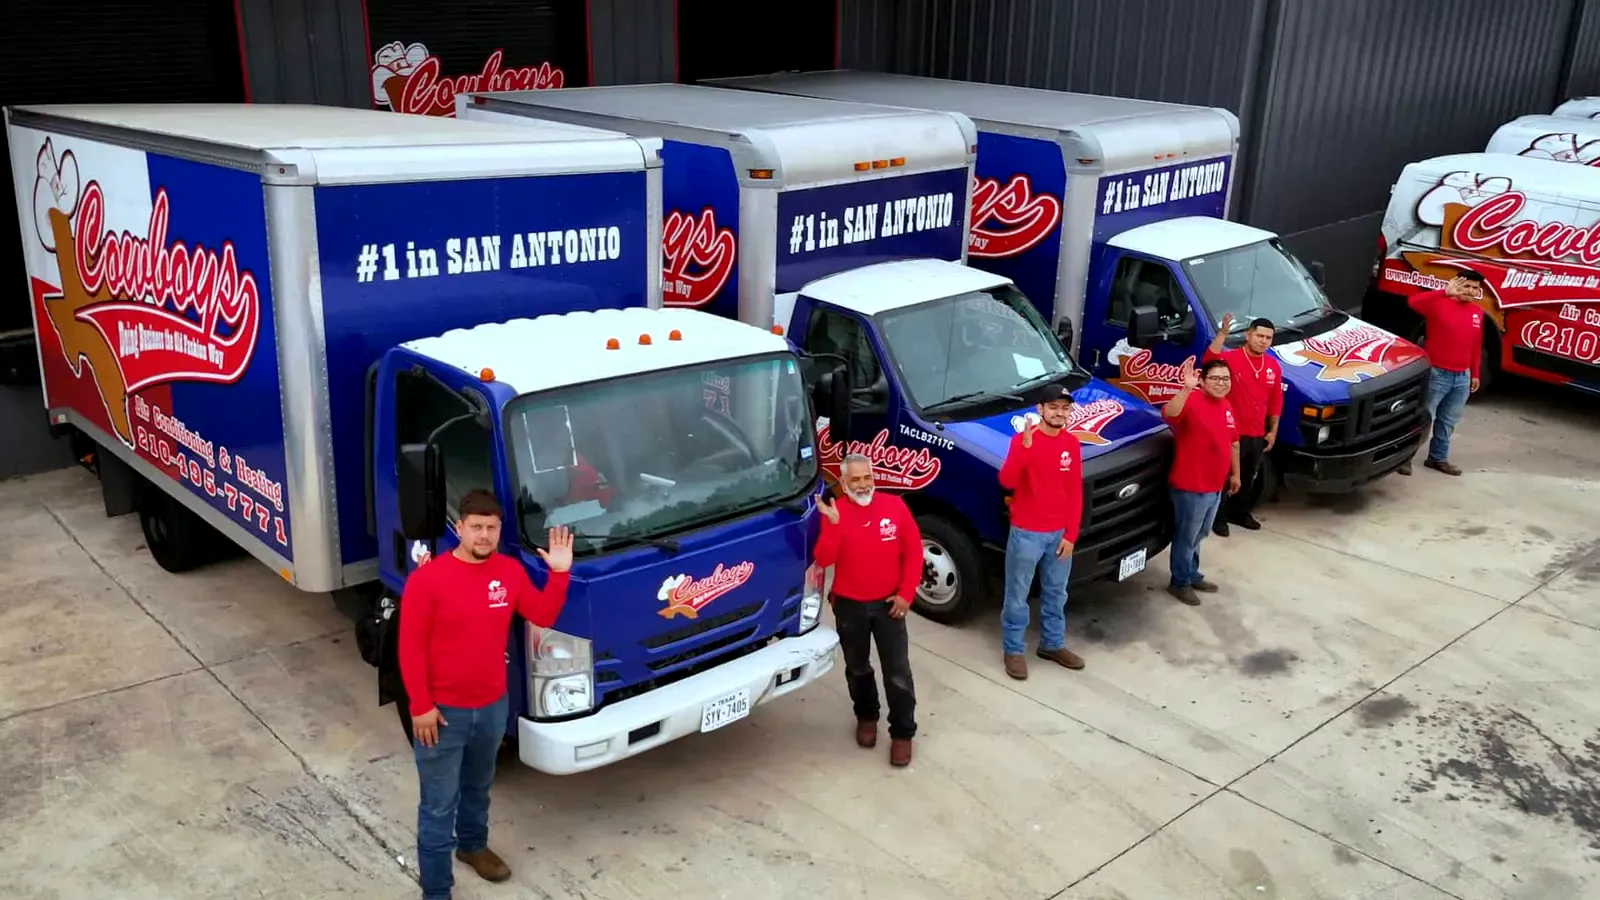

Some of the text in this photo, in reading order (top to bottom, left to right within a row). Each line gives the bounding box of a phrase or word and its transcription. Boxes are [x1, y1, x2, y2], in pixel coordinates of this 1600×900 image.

[1103, 161, 1225, 214] #1 in SAN ANTONIO
[790, 192, 953, 254] #1 in SAN ANTONIO
[74, 179, 259, 325] Cowboys
[356, 226, 620, 283] #1 in SAN ANTONIO
[1501, 268, 1540, 290] Doing
[1538, 271, 1584, 287] Business
[1559, 303, 1581, 321] Air
[207, 342, 224, 370] Way
[134, 394, 284, 513] Air Conditioning & Heating
[900, 424, 955, 450] TACLB2717C
[136, 426, 288, 546] 210-495-7771
[673, 560, 754, 602] Cowboys
[705, 697, 747, 726] SYV-7405
